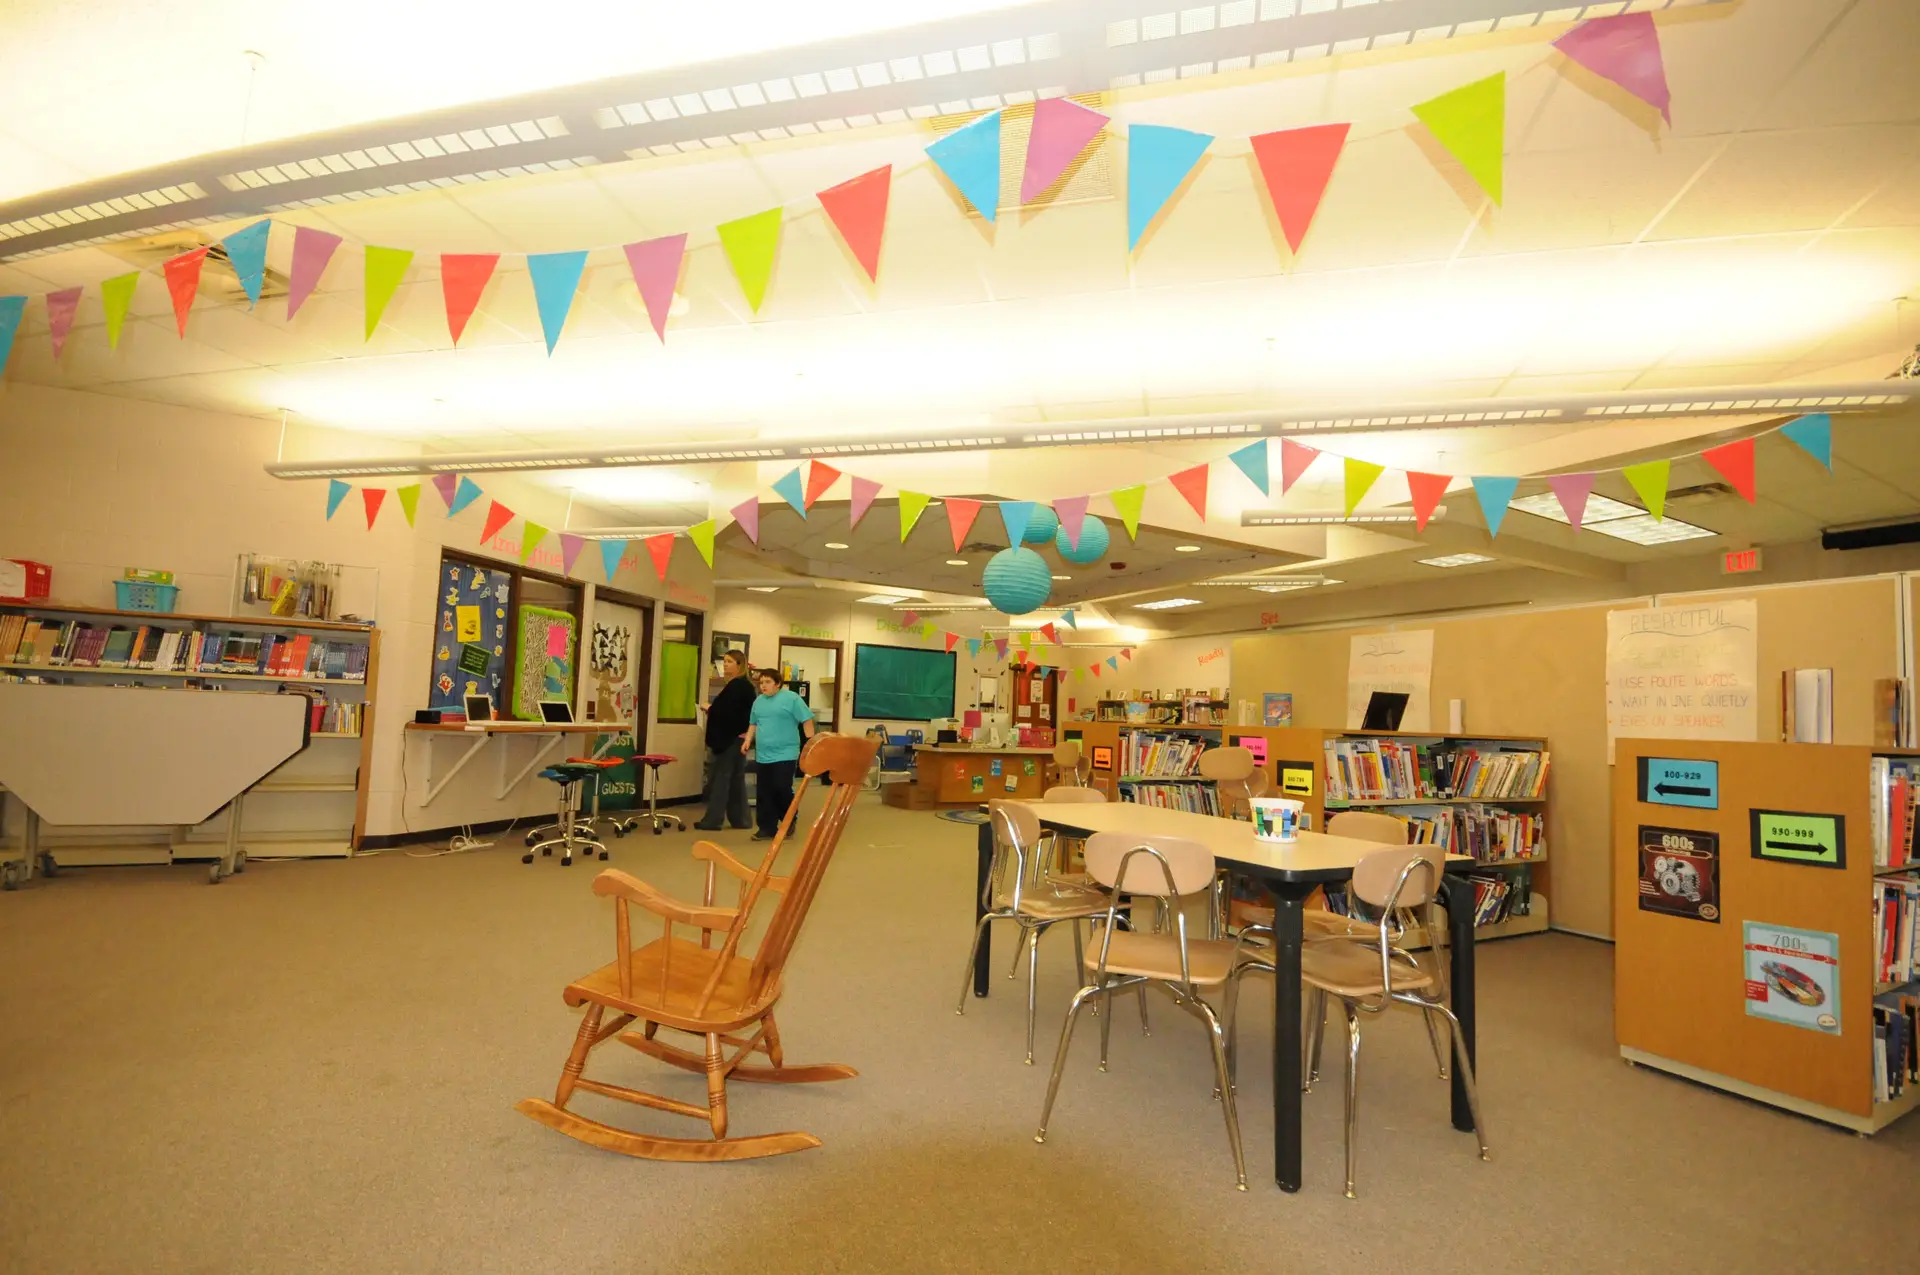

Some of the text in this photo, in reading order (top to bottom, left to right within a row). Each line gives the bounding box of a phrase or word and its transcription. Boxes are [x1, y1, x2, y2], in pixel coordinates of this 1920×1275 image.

[1726, 551, 1756, 572] EXIT
[1630, 608, 1731, 631] RESPECTFUL
[789, 622, 834, 639] Dream
[1197, 647, 1224, 667] Ready
[1619, 676, 1645, 689] USE
[1695, 673, 1738, 687] WORDS
[1620, 694, 1649, 709] WAIT
[1656, 694, 1667, 708] IN
[1701, 693, 1749, 708] QUIETLY
[601, 781, 636, 795] GUESTS
[1662, 834, 1694, 851] 600s
[1771, 934, 1809, 952] 700s
